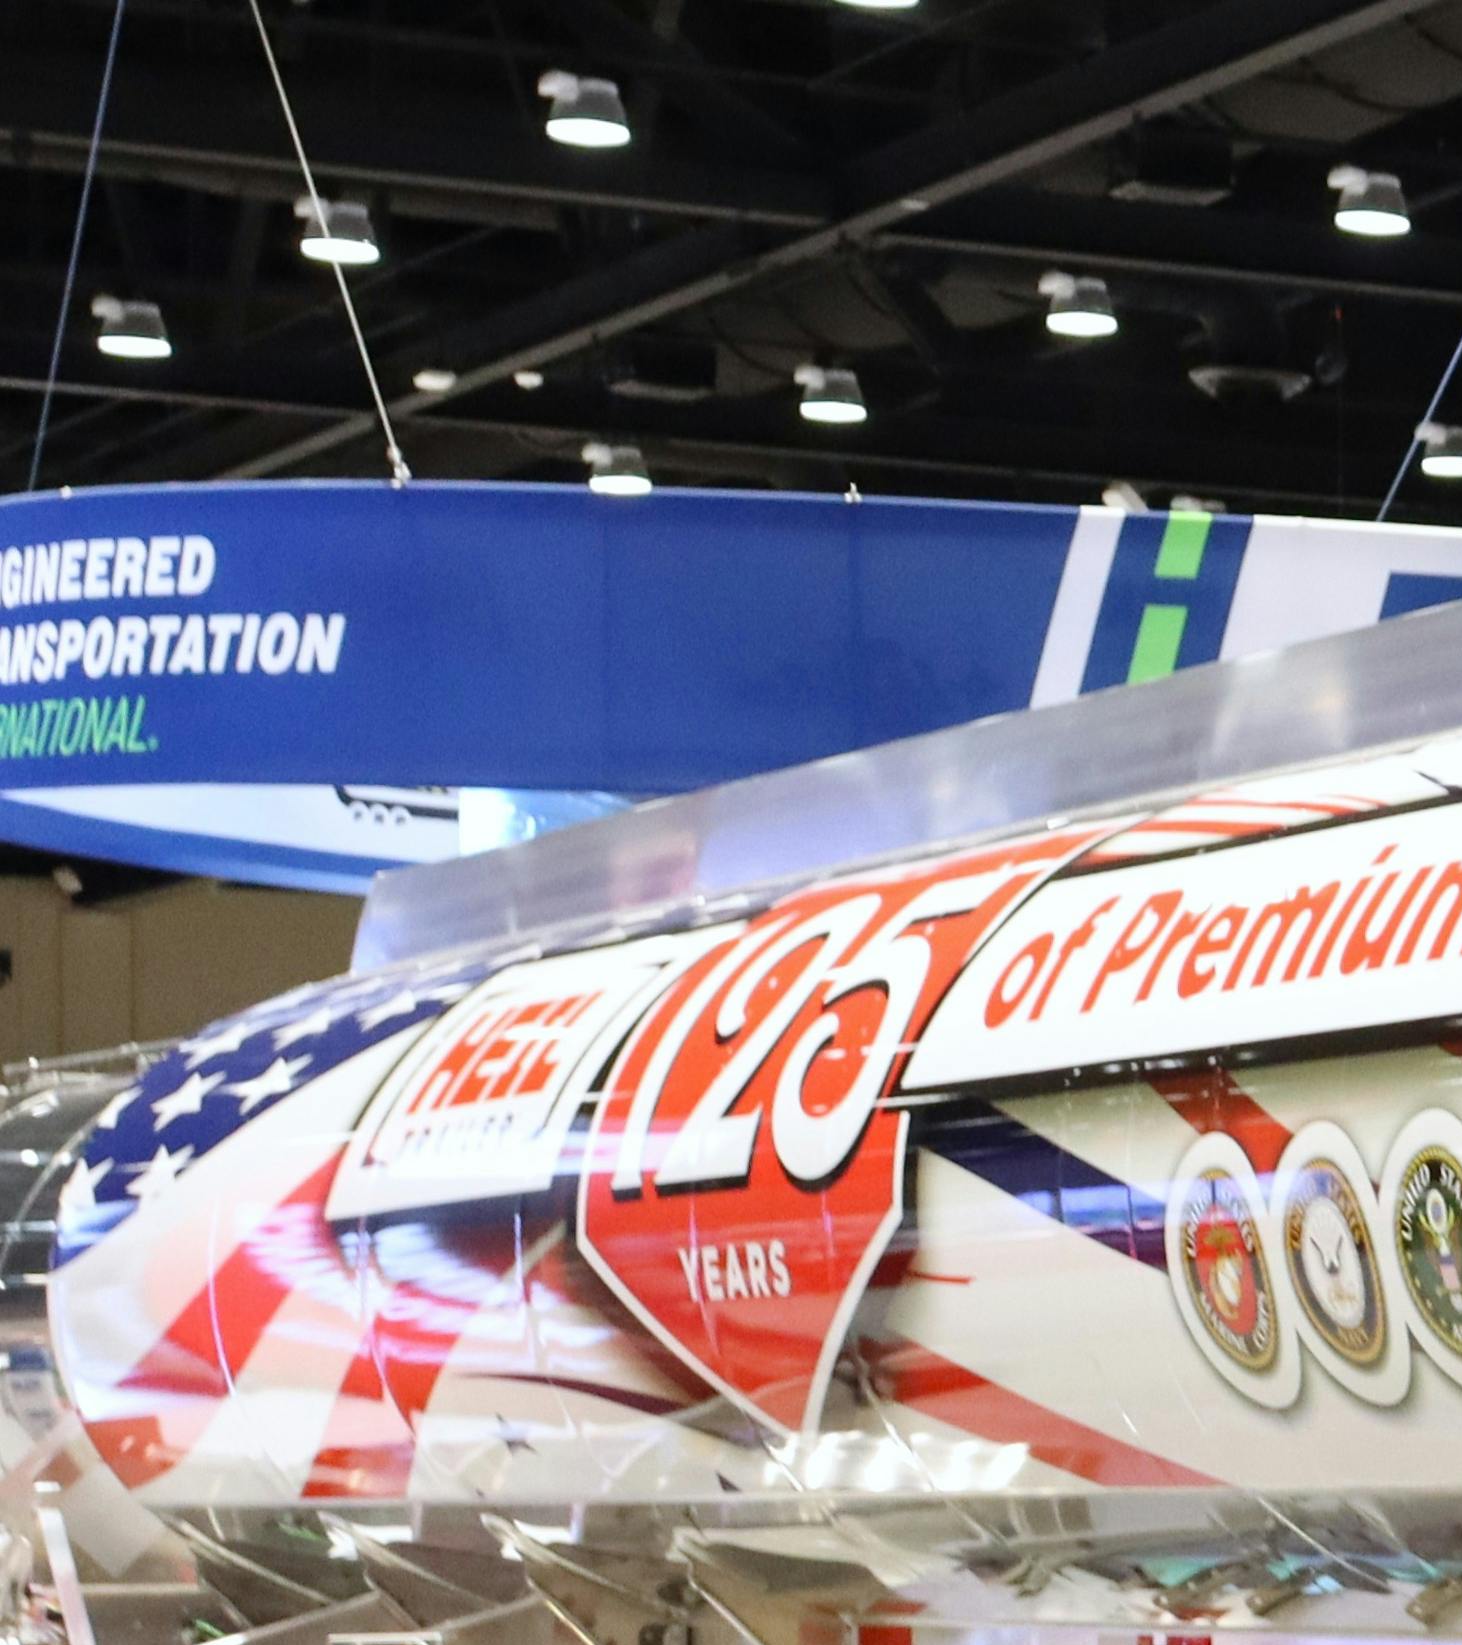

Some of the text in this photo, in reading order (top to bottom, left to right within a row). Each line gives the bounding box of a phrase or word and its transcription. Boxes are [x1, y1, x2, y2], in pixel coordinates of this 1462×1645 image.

[0, 535, 215, 609] GINEERED
[983, 895, 1120, 1030] of
[611, 858, 1035, 1197] 125
[677, 1239, 792, 1304] YEARS
